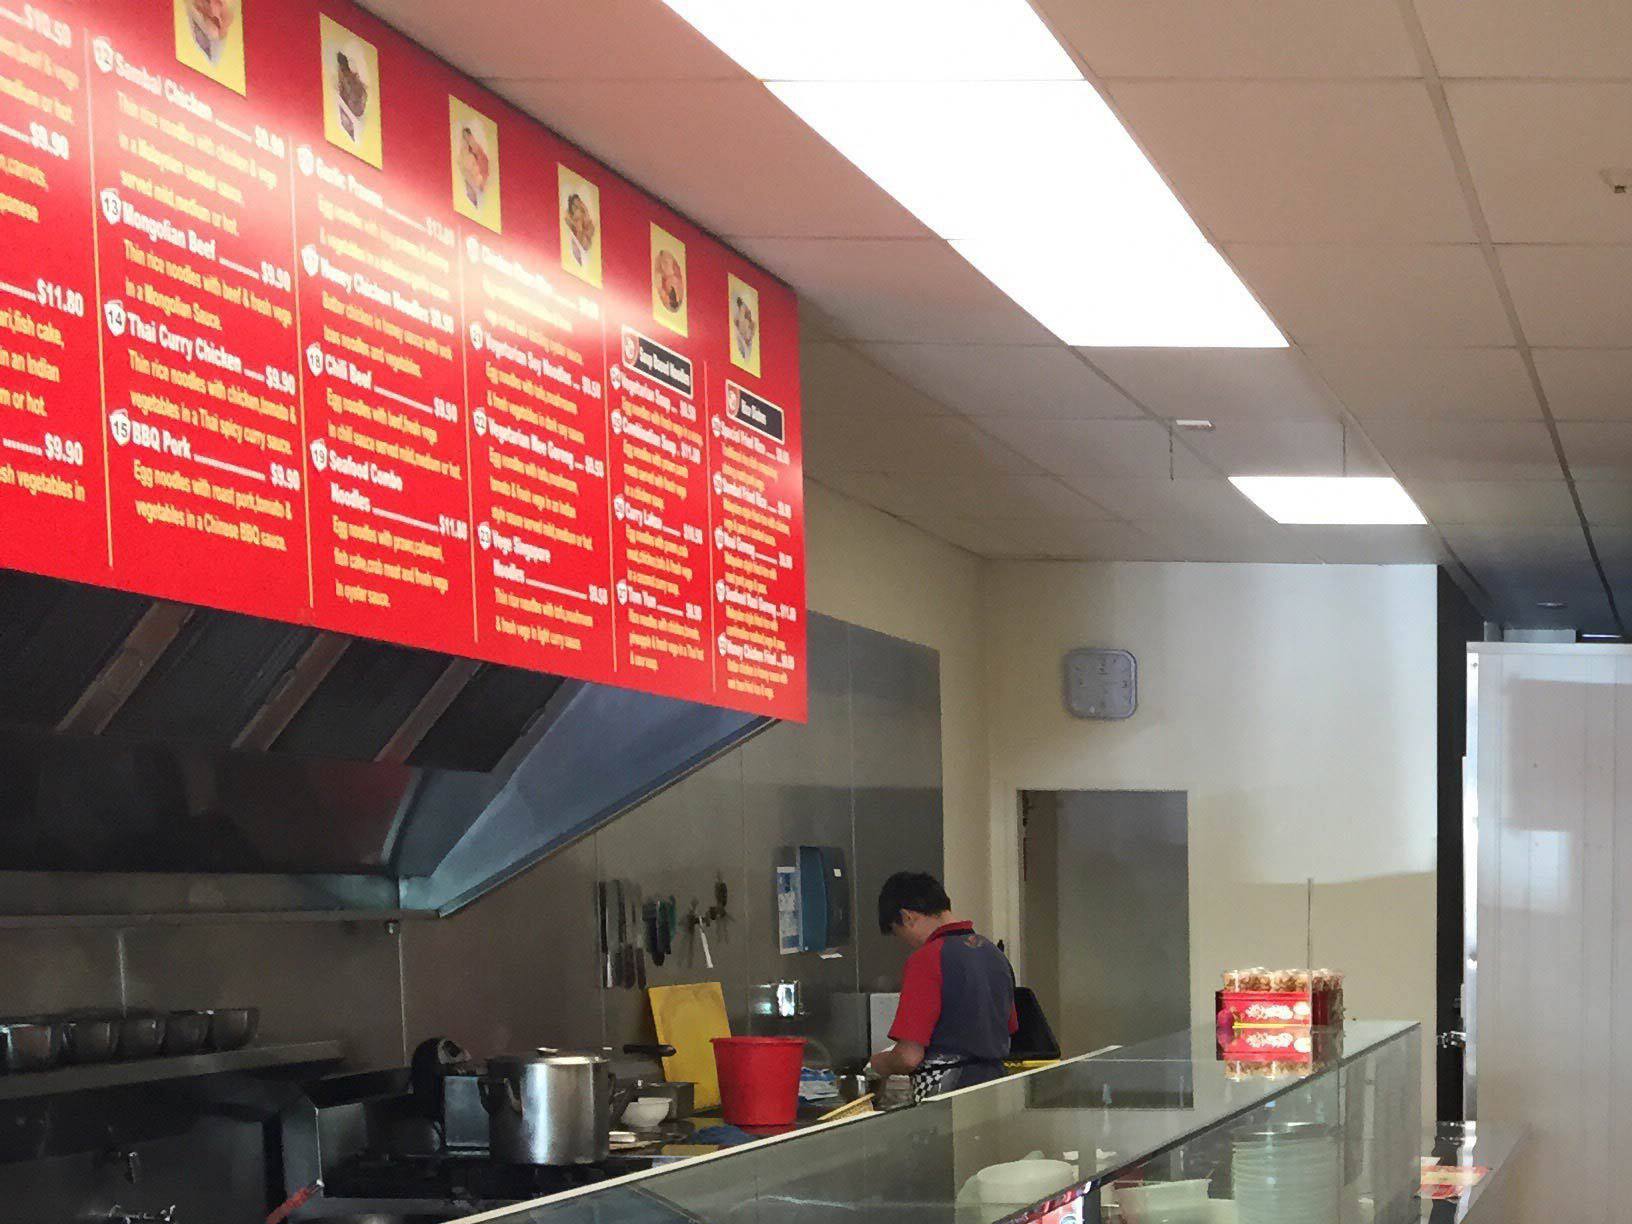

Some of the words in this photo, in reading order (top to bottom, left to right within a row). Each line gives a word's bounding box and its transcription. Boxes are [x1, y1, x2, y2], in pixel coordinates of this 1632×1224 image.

[122, 202, 185, 246] Mongolian
[188, 230, 215, 259] Beef
[261, 261, 290, 291] $9.90
[37, 279, 83, 315] $11.80
[27, 355, 59, 381] Indian
[127, 312, 156, 342] Thai
[158, 324, 192, 360] Curry
[195, 338, 241, 371] Chicken
[265, 366, 295, 394] $9.90
[130, 391, 179, 418] vegetables
[45, 433, 83, 464] $9.90
[132, 421, 159, 450] BBQ
[162, 430, 190, 458] Pork
[270, 463, 300, 489] $9.90
[133, 459, 153, 487] Egg
[153, 470, 190, 491] noodles
[329, 450, 368, 479] Seafood
[17, 471, 72, 497] vegetables
[330, 483, 370, 511] Noodles
[135, 501, 184, 525] vegetables
